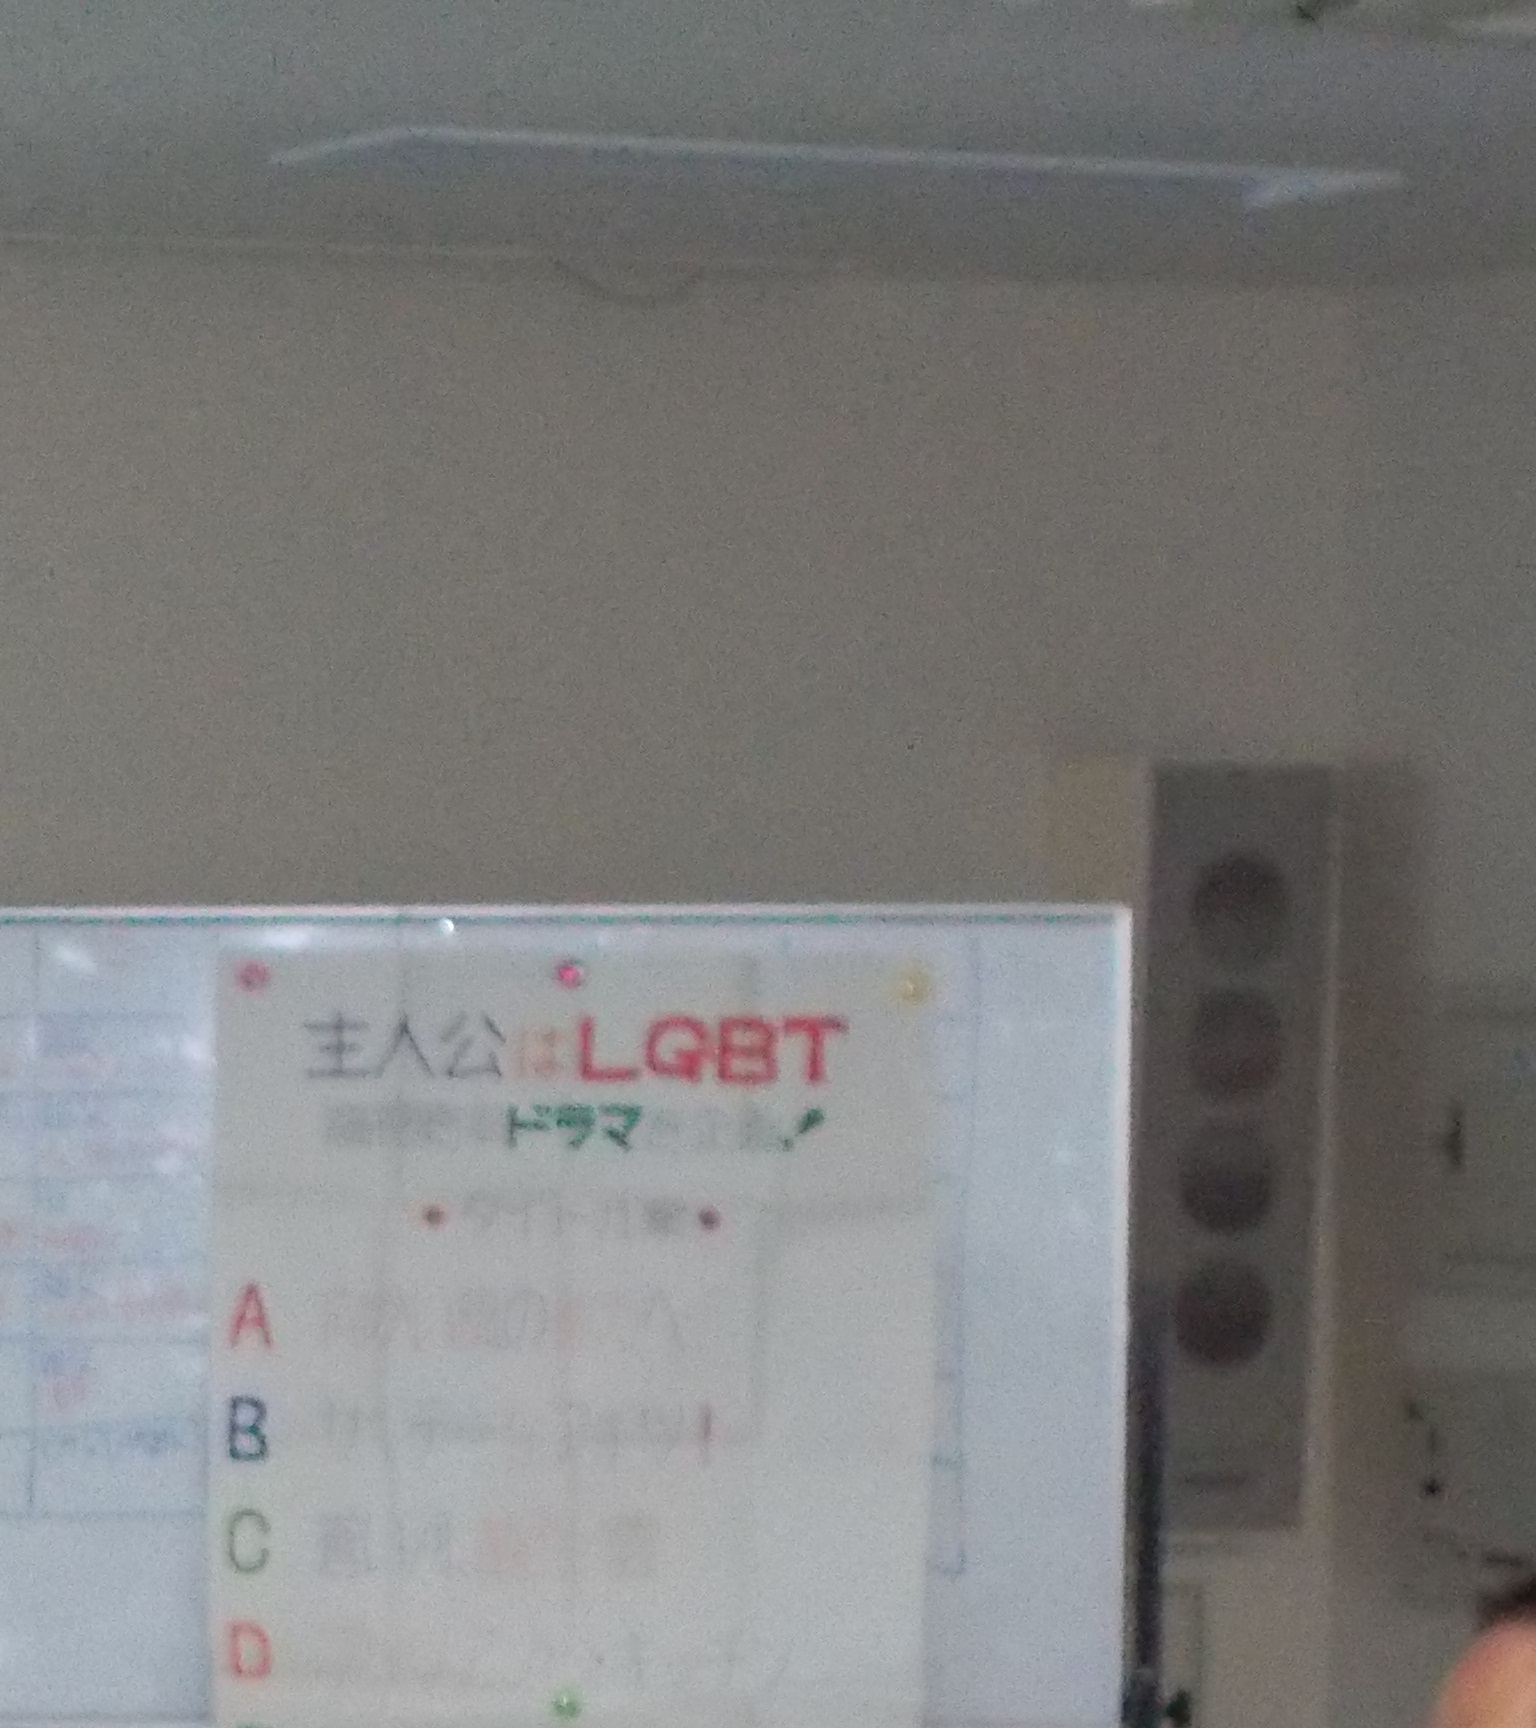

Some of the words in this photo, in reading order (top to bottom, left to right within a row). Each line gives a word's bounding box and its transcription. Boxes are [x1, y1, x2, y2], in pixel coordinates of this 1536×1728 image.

[228, 1282, 274, 1349] A
[228, 1396, 267, 1462] B
[227, 1509, 270, 1575] C
[229, 1620, 272, 1678] D
